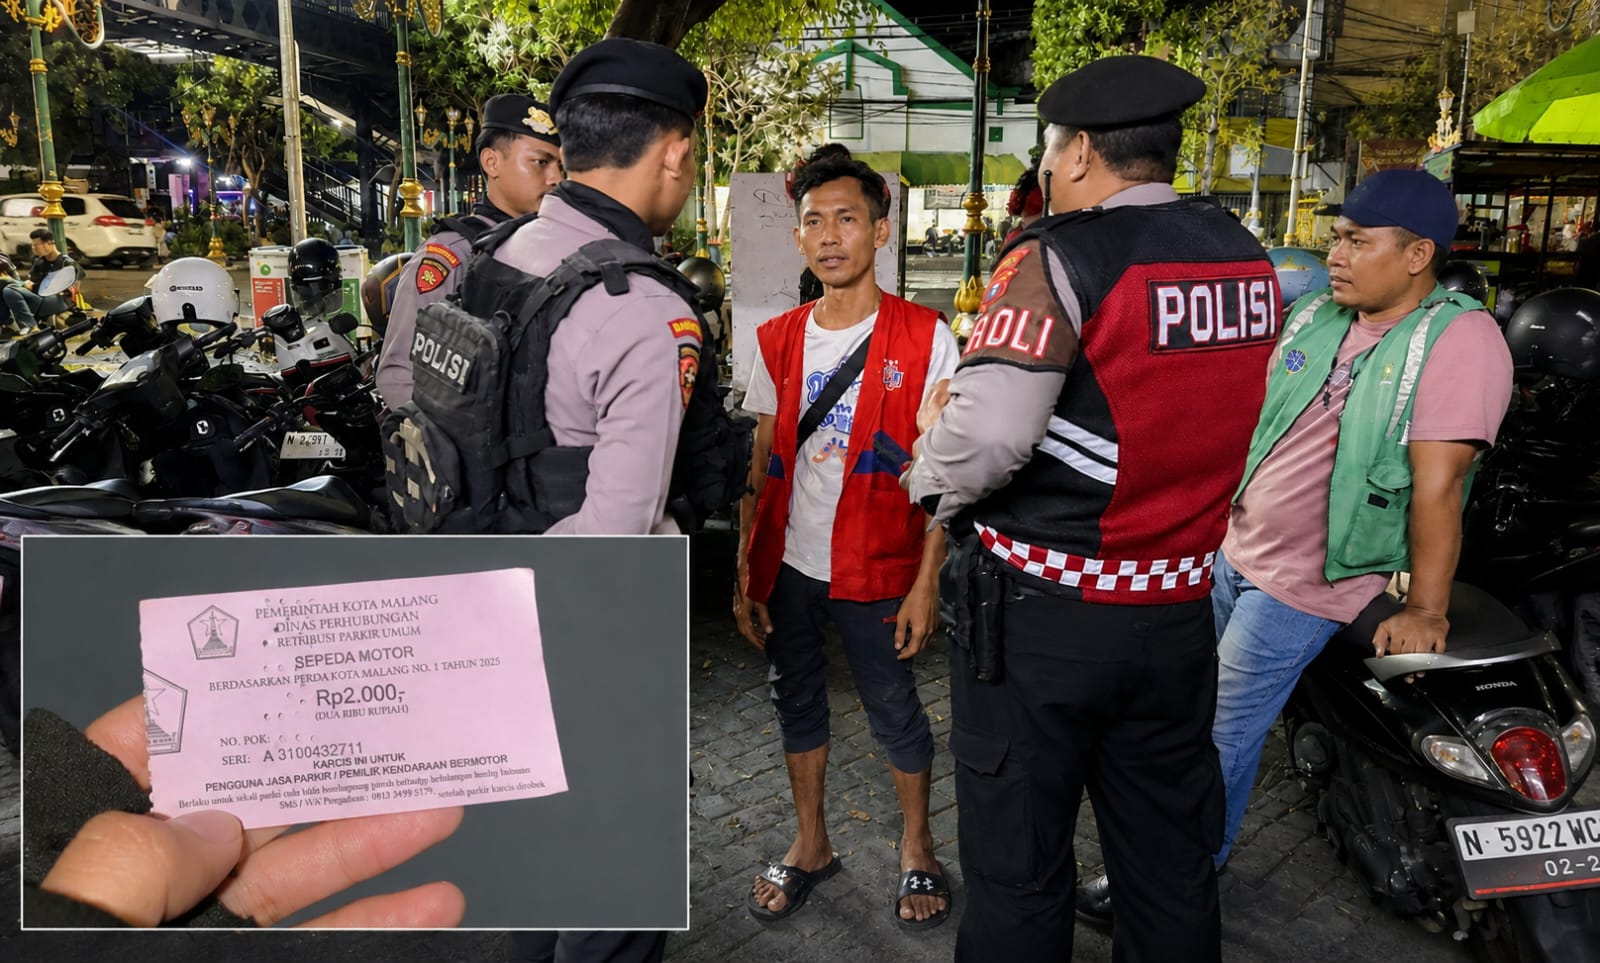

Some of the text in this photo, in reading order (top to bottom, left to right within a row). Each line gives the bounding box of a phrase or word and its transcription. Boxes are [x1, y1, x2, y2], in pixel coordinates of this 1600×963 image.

[1157, 280, 1275, 345] POLISI
[411, 332, 470, 385] POLISI
[255, 594, 438, 619] PEMERINTAH KOTA MALANG
[276, 610, 419, 634] DINAS PERHUBUNGAN
[277, 626, 421, 648] RETRIBUSI PARKIR UMUM
[295, 645, 414, 670] SEPEDA MOTOR
[209, 657, 500, 692] BERDASARKAN PERDA KOTA MALANG NO. 1 TAHUN 2025
[1475, 681, 1518, 691] HONDA
[315, 704, 409, 721] (DUA RIBU RUPIAH)
[220, 733, 270, 747] NO. POK:
[222, 742, 363, 766] SERI: A 3100432711
[313, 752, 405, 769] KARCIS INI UNTUK
[205, 778, 263, 792] PENGGUNA
[266, 776, 292, 787] JASA
[294, 772, 331, 784] PARKIR
[339, 766, 381, 779] PEMILIK
[383, 761, 447, 775] KENDARAAN
[450, 754, 508, 769] BERMOTOR
[279, 800, 298, 810] SMS
[372, 792, 391, 801] 0813
[393, 789, 413, 799] 3499
[1462, 829, 1484, 856] N
[1498, 821, 1568, 853] 5922
